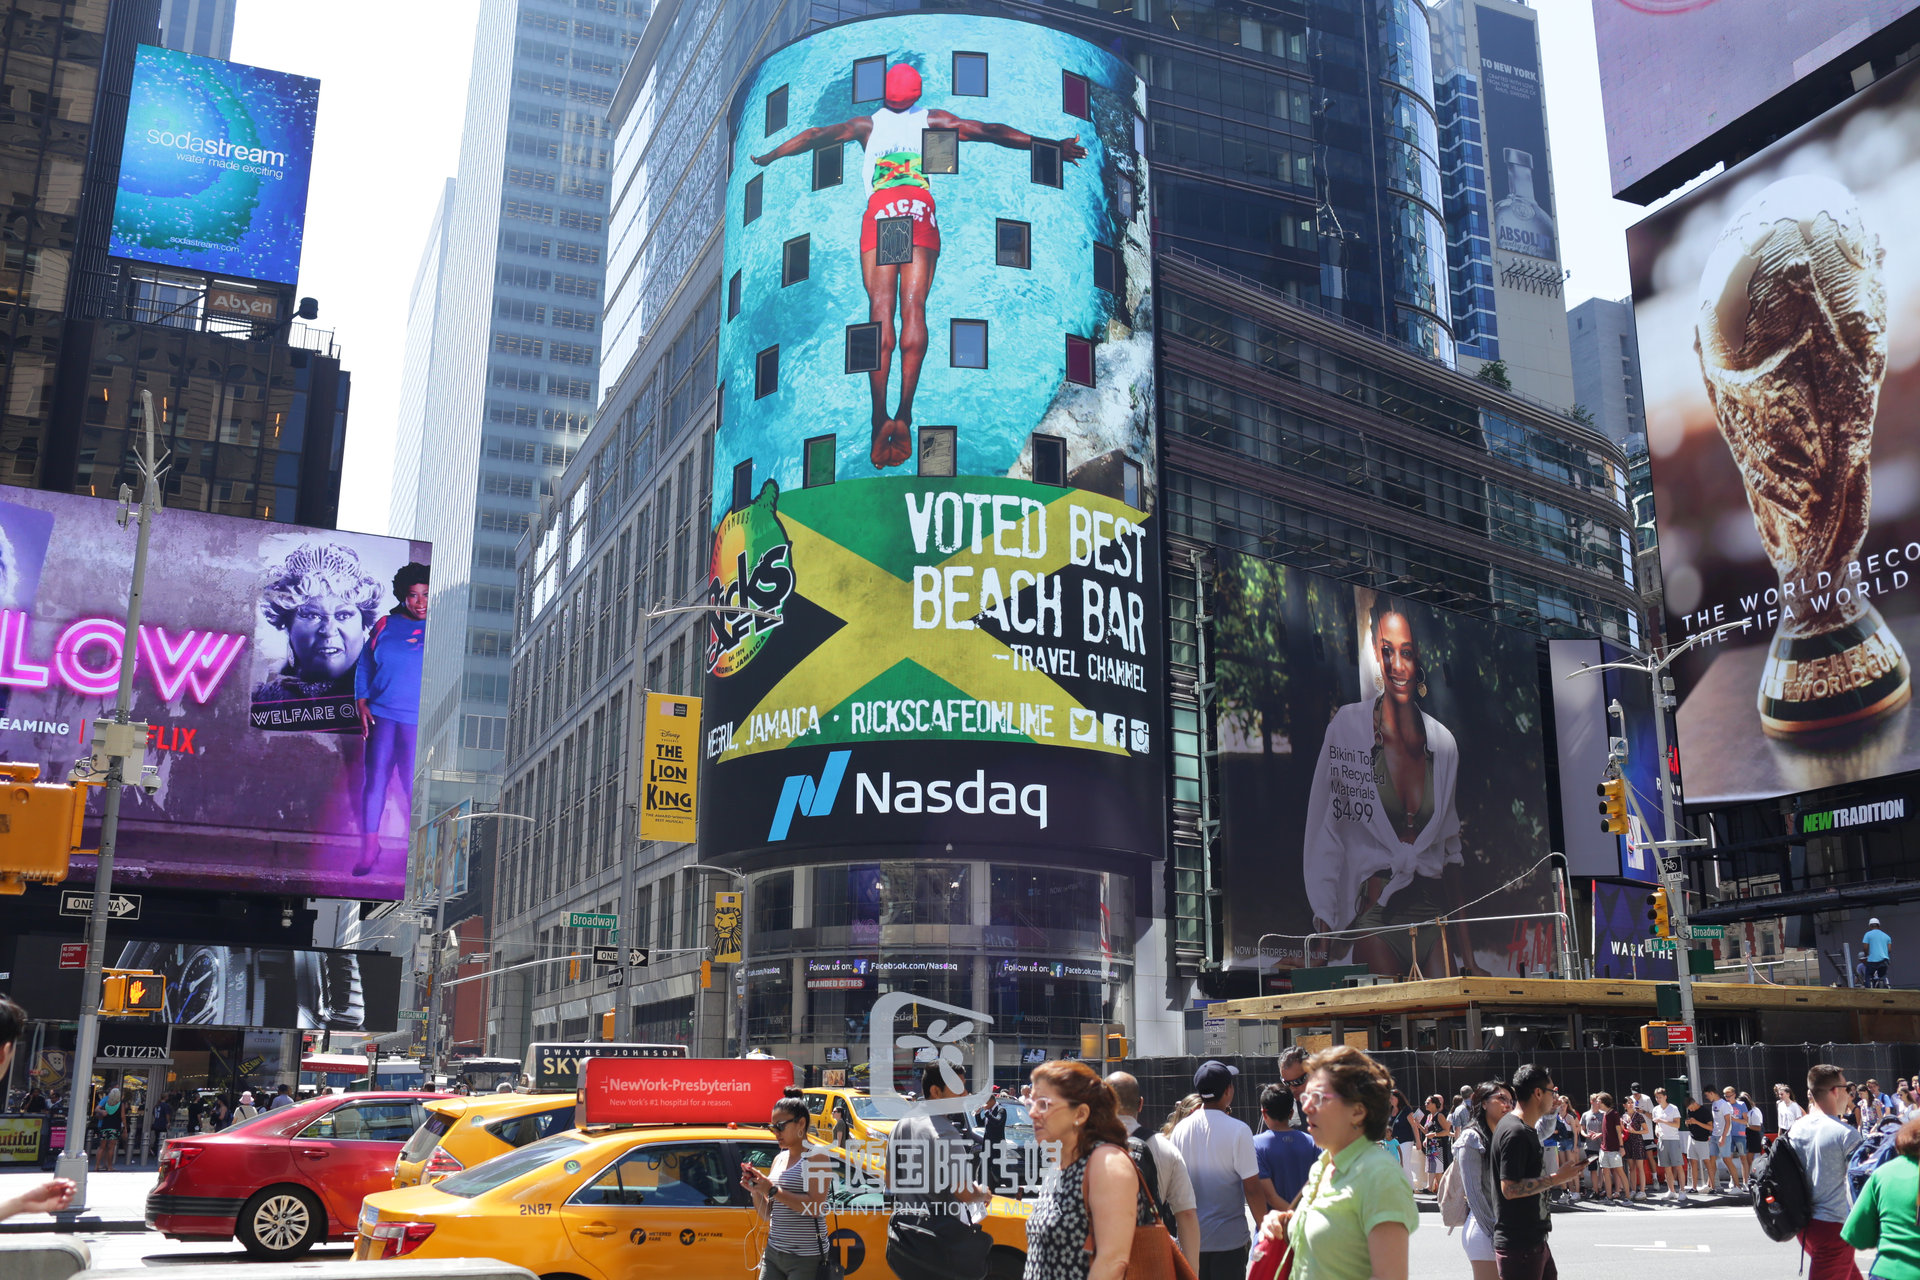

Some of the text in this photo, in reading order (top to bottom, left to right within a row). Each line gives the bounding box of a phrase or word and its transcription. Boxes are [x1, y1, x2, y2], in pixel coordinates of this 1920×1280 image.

[1481, 57, 1492, 68] TO
[1494, 61, 1511, 74] NEW
[147, 129, 284, 167] sodastream
[176, 153, 284, 180] water made exciting
[169, 236, 240, 253] sodastream.com
[905, 492, 1146, 583] VOTED BEST
[1682, 542, 1920, 631] THE WORLD BECO
[913, 565, 1146, 655] BEACH BAR
[1686, 570, 1909, 651] THE FIFA WORLD
[735, 636, 766, 668] JAMAICA
[1088, 654, 1147, 693] CHANNEL
[252, 706, 336, 725] WELFARE
[659, 729, 680, 740] Disney
[707, 700, 1056, 761] NEGRIL, JAMAICA RICKSCAFEONLINE
[146, 724, 197, 755] FLIX
[656, 744, 683, 759] THE
[1329, 746, 1376, 769] Bikini Top
[650, 760, 687, 782] LION
[1330, 763, 1385, 785] in Recycled
[646, 783, 692, 811] KING
[856, 769, 1048, 829] Nasdaq
[1331, 780, 1375, 801] Materials
[1333, 797, 1374, 823] $4.99
[1670, 872, 1682, 882] LANE
[73, 899, 94, 909] ONE
[572, 914, 616, 929] Broadway
[1693, 927, 1722, 938] Broadway
[1661, 938, 1670, 949] 43
[601, 951, 641, 961] ONE AY
[1234, 946, 1251, 955] NOW
[1261, 948, 1288, 957] STORES
[1288, 949, 1303, 959] AND
[809, 962, 831, 971] Follow
[841, 963, 853, 971] on:
[1004, 963, 1028, 972] Follow
[1029, 964, 1038, 972] us
[807, 979, 863, 988] BRANDED CITIES
[399, 1011, 427, 1020] BROADWAY
[254, 1036, 276, 1044] CITIZEN
[104, 1045, 168, 1058] CITIZEN
[613, 1049, 678, 1057] JOHNSON
[609, 1078, 751, 1095] NewYork-Presbyterian
[609, 1098, 626, 1106] New
[627, 1098, 649, 1106] York's
[649, 1098, 659, 1106] #1
[660, 1098, 689, 1108] hospital
[690, 1098, 700, 1106] for
[519, 1203, 552, 1216] 2N87
